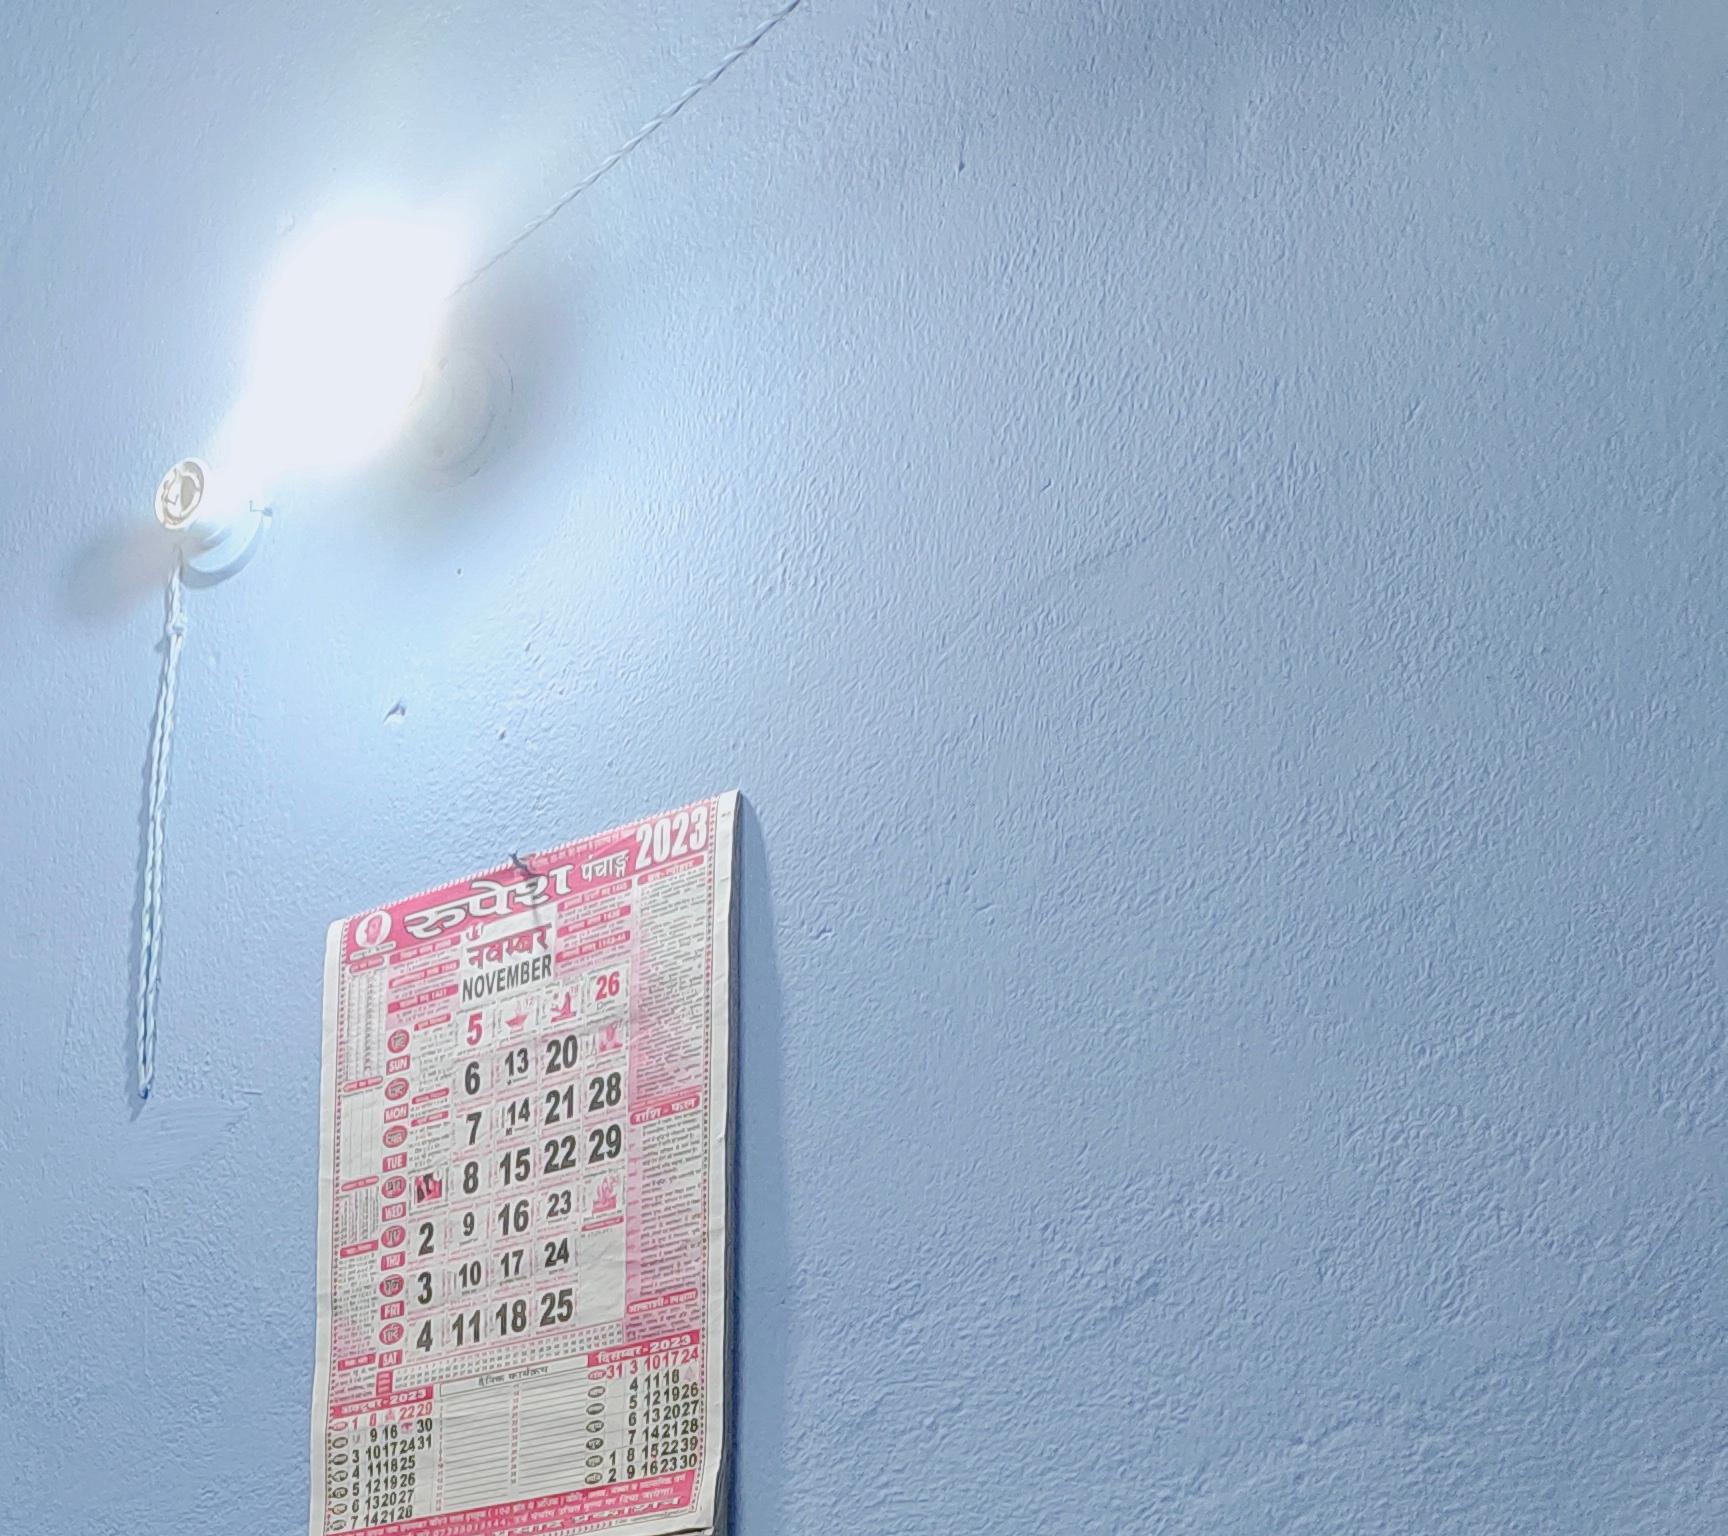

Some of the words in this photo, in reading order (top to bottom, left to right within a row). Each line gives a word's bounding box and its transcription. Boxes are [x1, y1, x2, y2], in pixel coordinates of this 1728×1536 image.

[635, 806, 708, 870] 2023
[462, 954, 552, 1002] NOVEMBER
[388, 1057, 408, 1072] SUN
[466, 1011, 483, 1046] 5
[595, 971, 620, 1001] 26
[385, 1106, 407, 1121] MON
[465, 1061, 480, 1095] 6
[505, 1048, 529, 1076] 13
[546, 1035, 578, 1074] 20
[386, 1154, 403, 1168] TUE
[466, 1112, 482, 1145] 7
[507, 1098, 530, 1126] 14
[545, 1084, 574, 1125] 21
[588, 1072, 622, 1112] 28
[385, 1204, 403, 1218] WED
[463, 1161, 478, 1194] 8
[500, 1148, 530, 1186] 15
[544, 1135, 576, 1174] 22
[588, 1124, 622, 1164] 29
[418, 1222, 434, 1256] 2
[463, 1212, 475, 1236] 9
[498, 1200, 529, 1236] 16
[546, 1190, 572, 1218] 23
[384, 1304, 400, 1317] FRI
[417, 1271, 432, 1304] 3
[458, 1260, 481, 1288] 10
[500, 1250, 524, 1278] 17
[544, 1238, 570, 1268] 24
[383, 1353, 398, 1364] SAT
[416, 1320, 433, 1352] 4
[452, 1310, 480, 1346] 11
[496, 1299, 527, 1336] 18
[540, 1288, 573, 1327] 25
